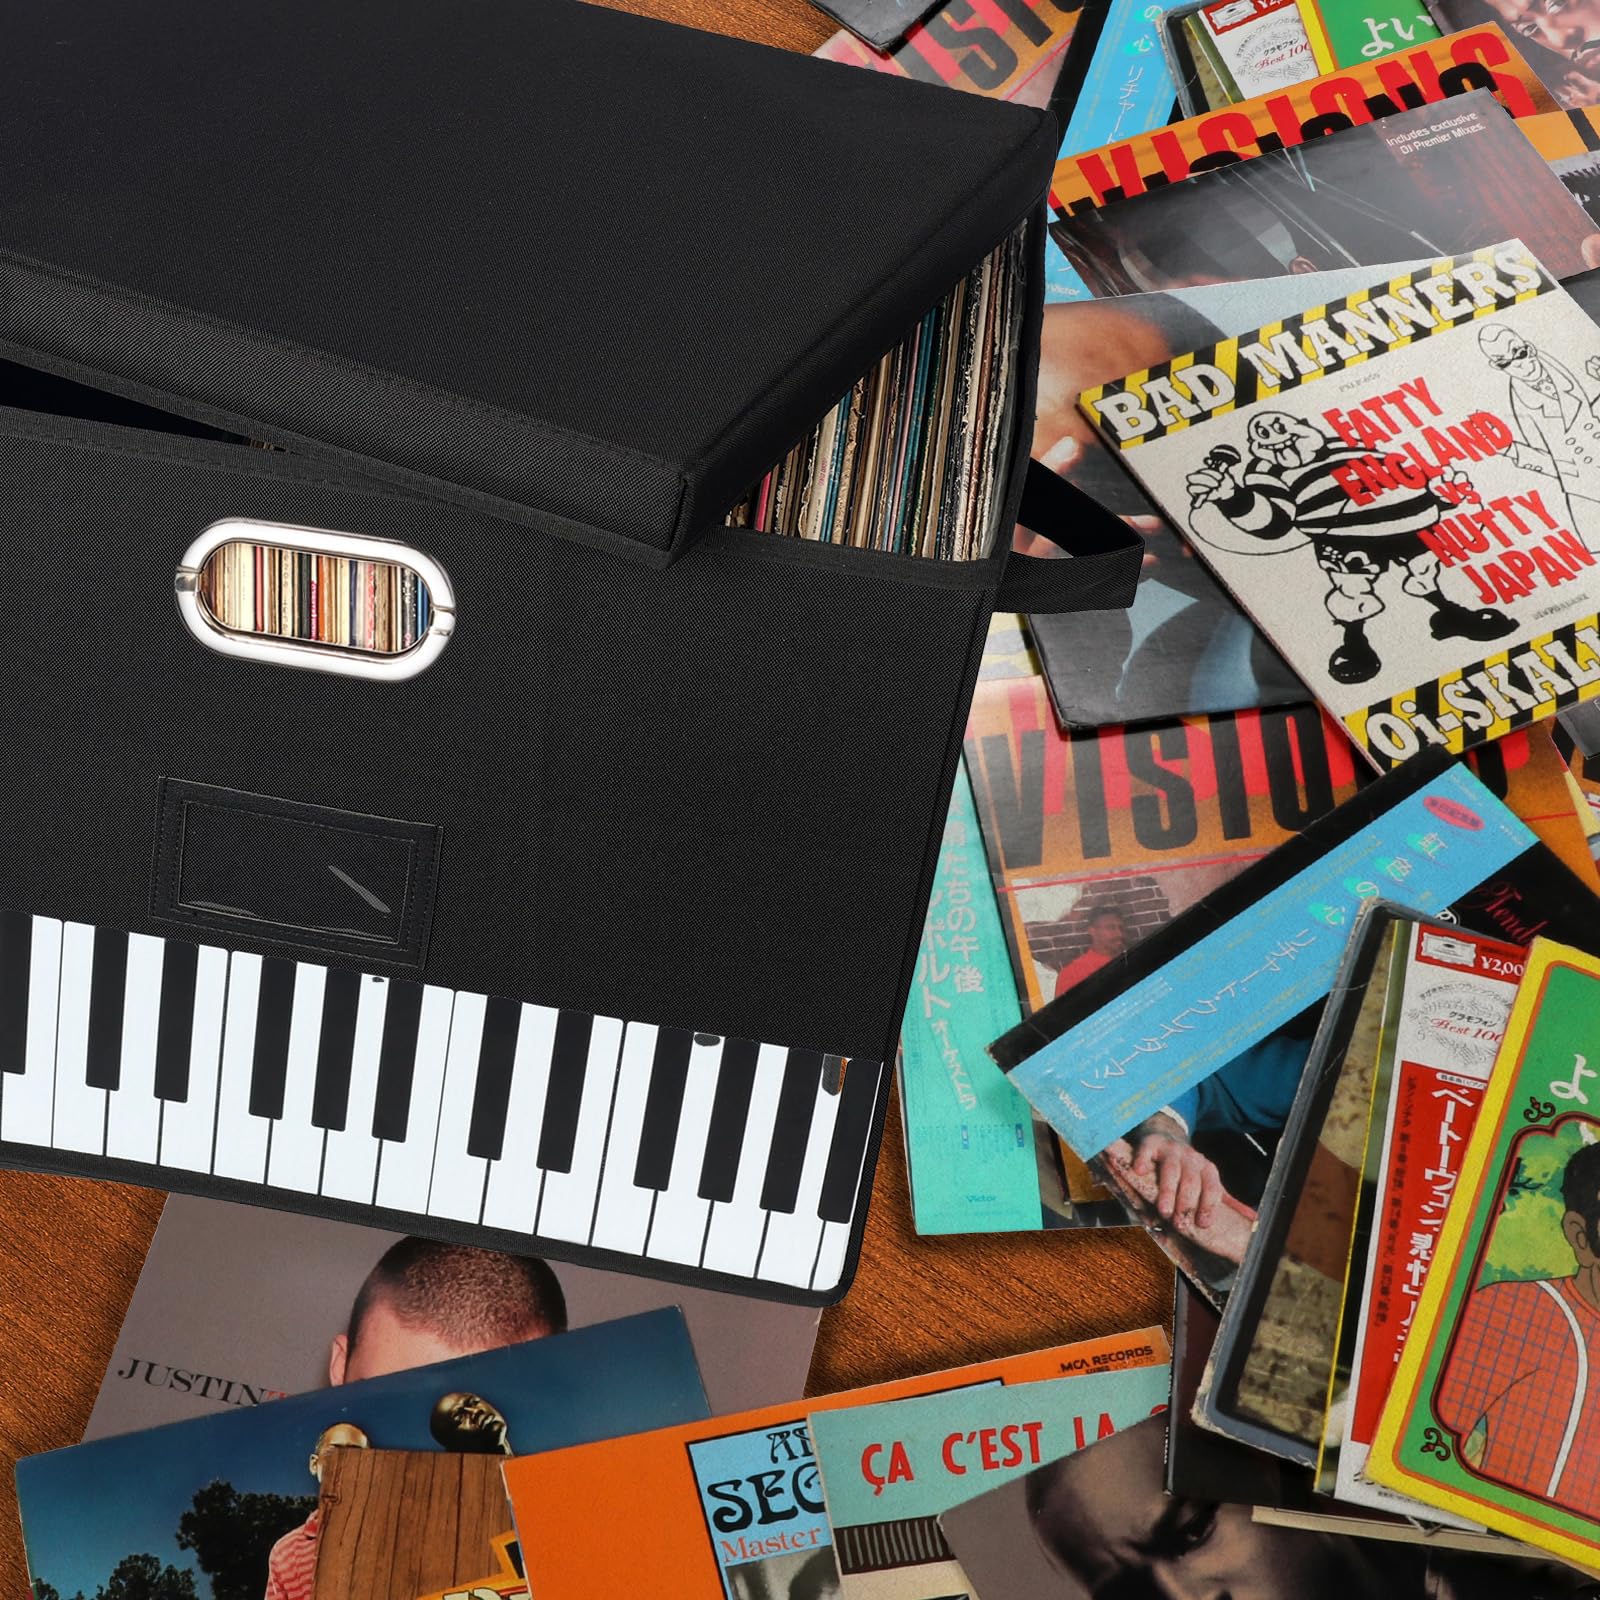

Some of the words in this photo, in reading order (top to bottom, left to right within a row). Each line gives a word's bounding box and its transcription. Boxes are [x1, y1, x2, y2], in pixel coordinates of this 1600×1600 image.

[1385, 127, 1431, 147] Includes
[1430, 111, 1479, 133] exclusive
[1413, 132, 1453, 151] Premier
[1093, 363, 1236, 441] BAD
[1238, 247, 1544, 388] MANNERS
[1322, 376, 1444, 451] FATTY
[1329, 410, 1513, 506] ENGLAND
[1416, 490, 1560, 568] NUTTY
[1461, 529, 1598, 605] JAPAN
[1429, 1017, 1470, 1035] Best
[1059, 1357, 1090, 1373] MCA
[1091, 1345, 1154, 1366] RECORDS
[860, 1440, 915, 1496] ÇA
[941, 1421, 1043, 1476] C'EST
[719, 1526, 823, 1563] Master
